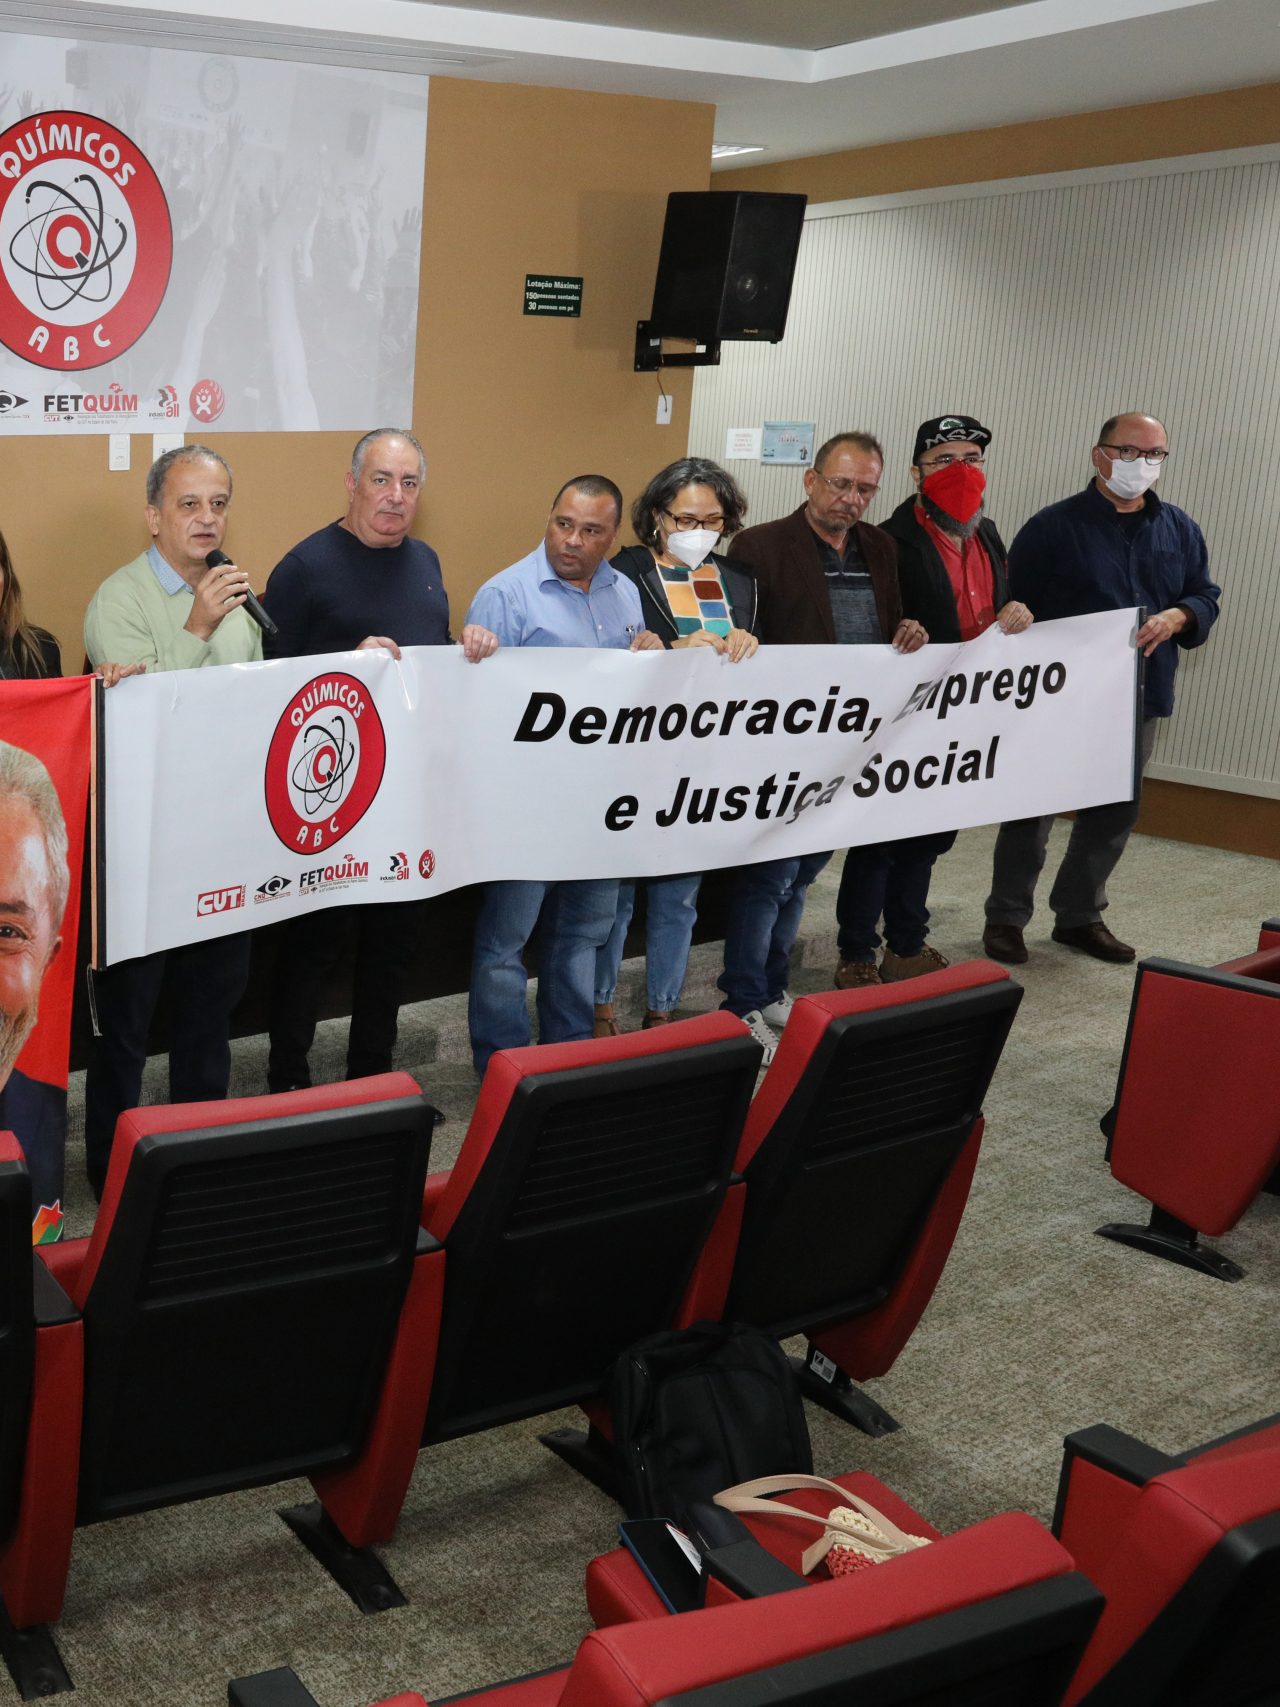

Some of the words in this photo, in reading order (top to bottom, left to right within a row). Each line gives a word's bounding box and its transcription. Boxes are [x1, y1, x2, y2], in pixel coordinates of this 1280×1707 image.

[527, 280, 552, 289] Lotação
[554, 281, 580, 289] Máxima:
[528, 301, 537, 310] 30
[44, 394, 138, 412] FETQUIM
[925, 429, 988, 449] MST
[291, 681, 364, 726] QUÍMICOS
[514, 686, 881, 744] Democracia,
[605, 795, 638, 831] e
[656, 771, 846, 827] Justiça
[853, 735, 1000, 798] Social
[199, 890, 240, 915] CUT
